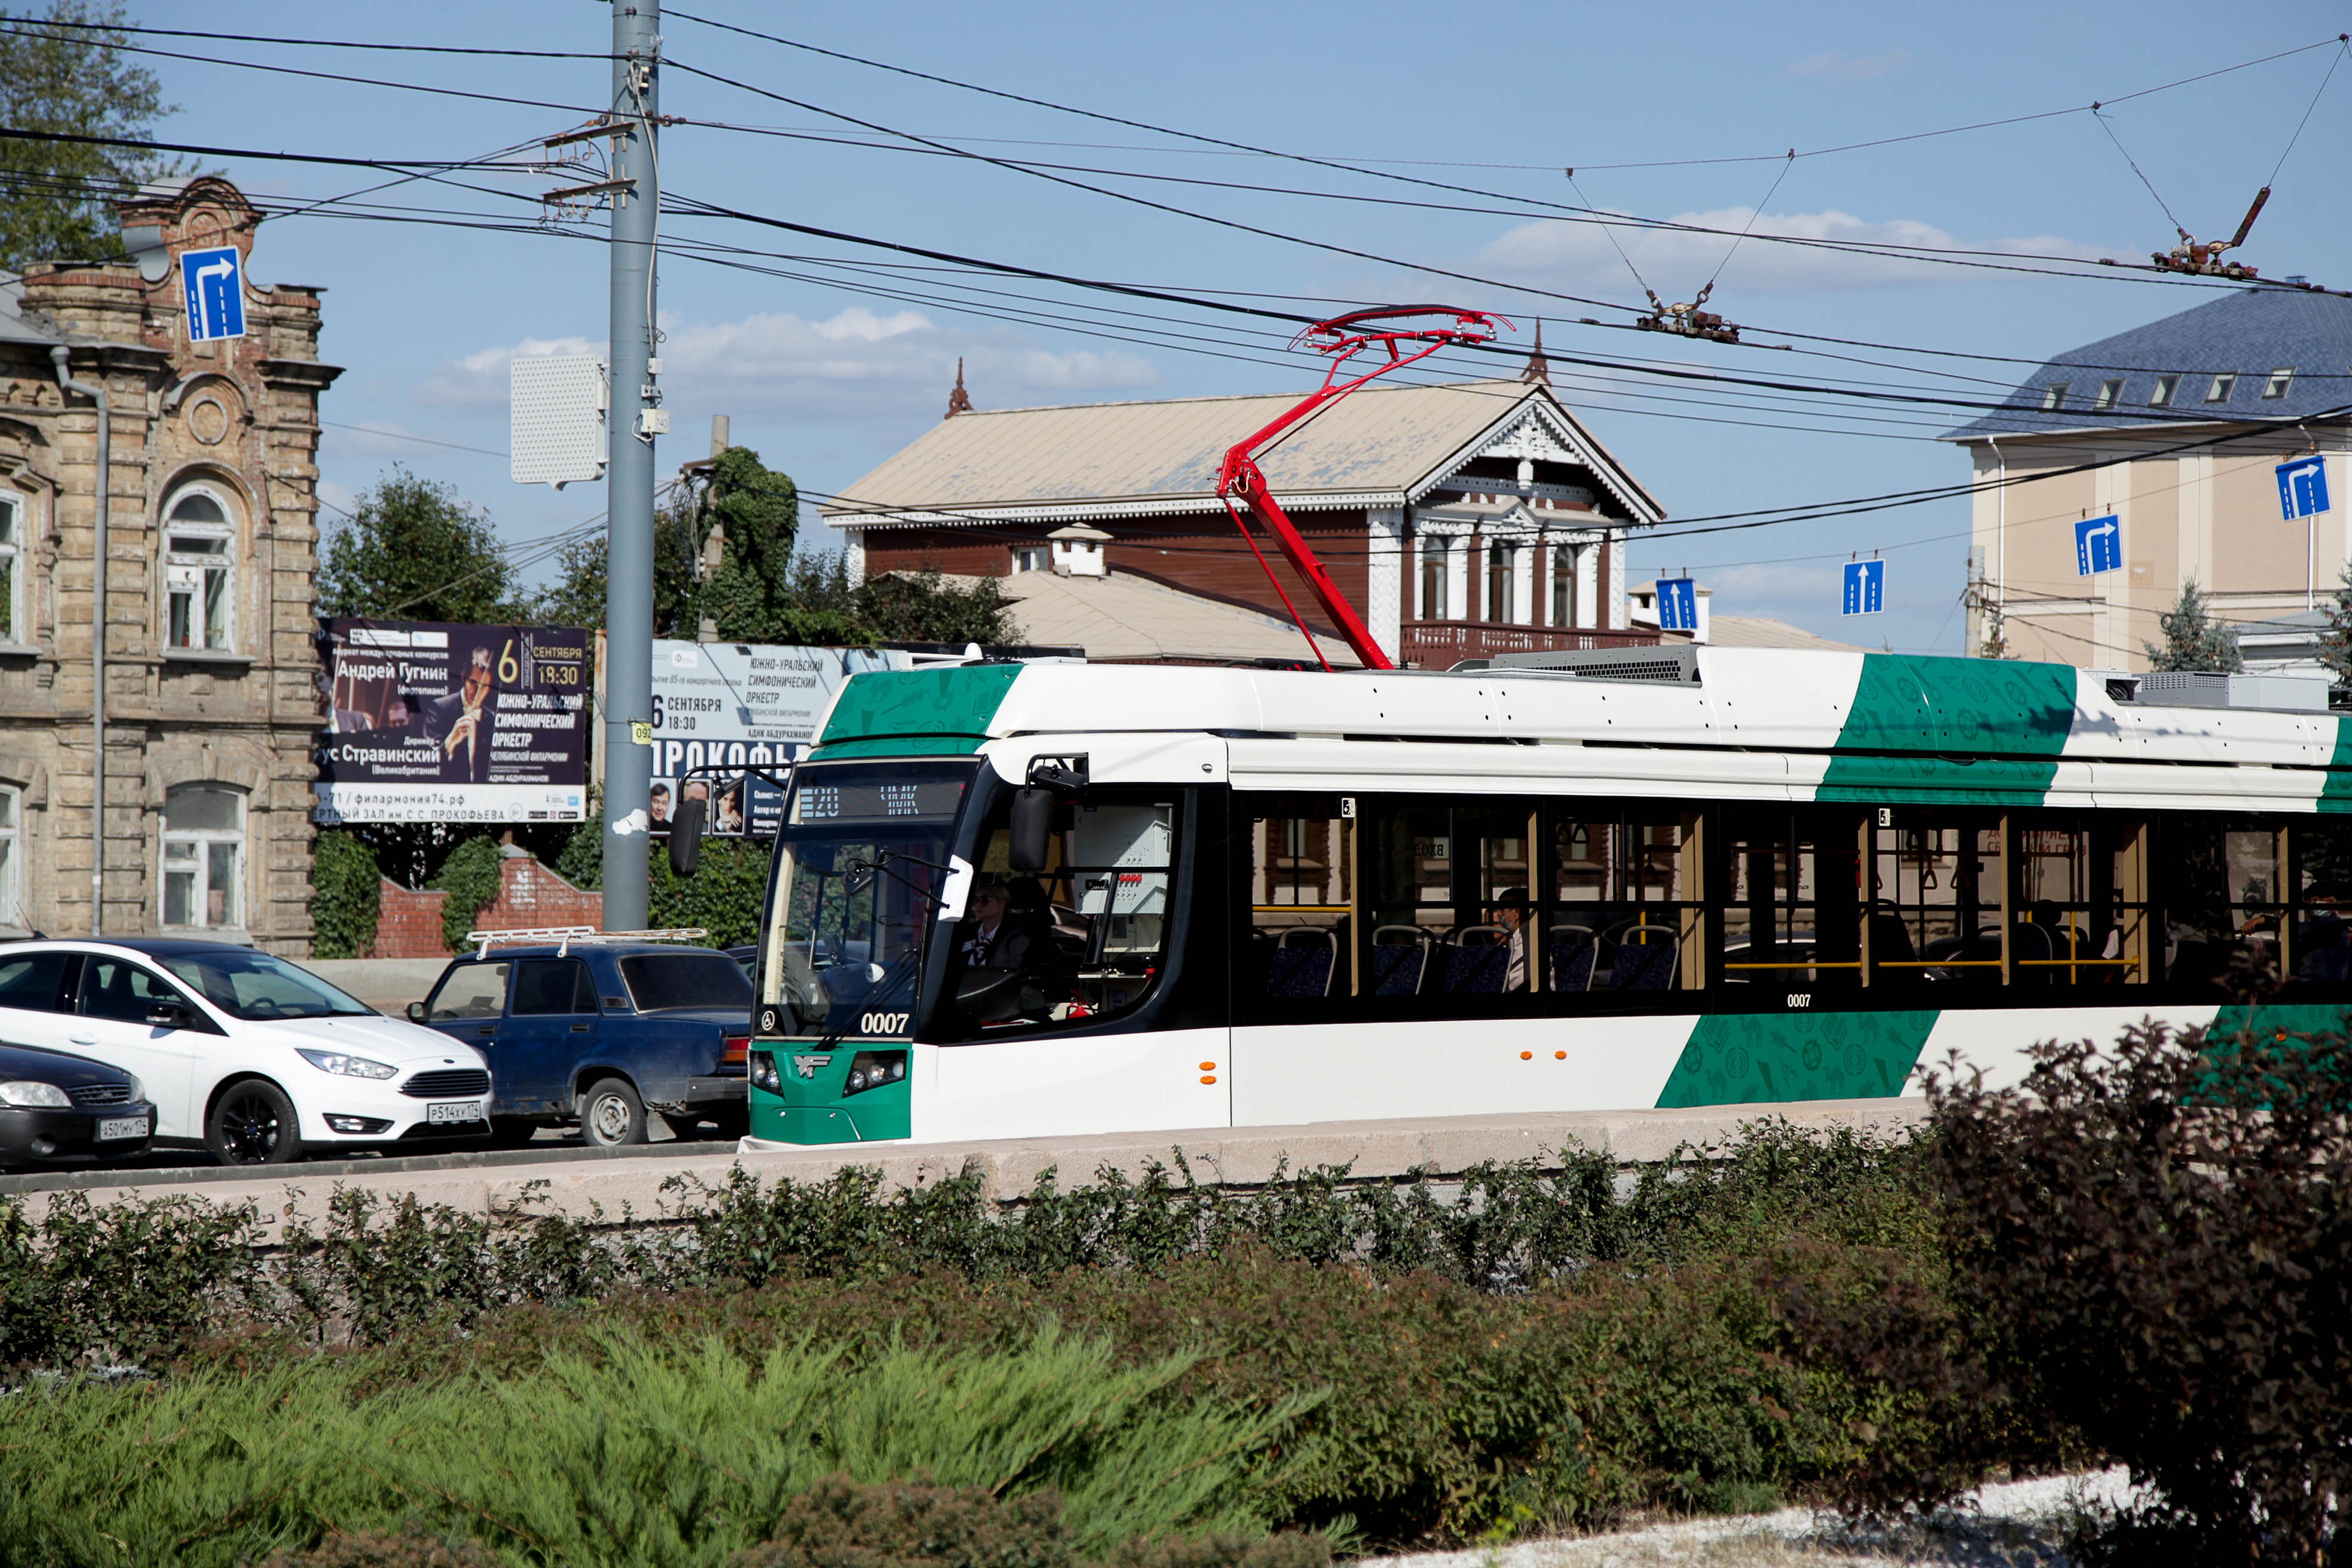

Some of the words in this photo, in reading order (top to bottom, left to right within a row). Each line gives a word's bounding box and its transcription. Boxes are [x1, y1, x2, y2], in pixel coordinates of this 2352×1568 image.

[415, 650, 449, 661] конкурсов
[533, 646, 583, 659] СЕНТЯБРЯ
[498, 639, 519, 683] 6
[750, 658, 823, 672] ЮЖНО-УРАЛЬСКИЙ
[337, 660, 395, 682] Андрей
[399, 662, 449, 683] Гугнин
[538, 665, 578, 685] 18:30
[748, 674, 817, 689] СИМФОНИЧЕСКИЙ
[497, 693, 584, 710] ЮЖНО-УРАЛЬСКИЙ
[667, 696, 722, 712] СЕНТЯБРЯ
[746, 692, 779, 704] ОРКЕСТР
[495, 713, 575, 729] СИМФОНИЧЕСКИЙ
[669, 716, 696, 730] 18:30
[492, 732, 533, 747] ОРКЕСТР
[747, 729, 764, 738] АДИК
[342, 743, 440, 765] Стравинский
[372, 764, 440, 776] (Великобритания)
[363, 809, 384, 820] ЗАЛ
[431, 809, 505, 820] ПРОКОФЬЕВА
[1787, 994, 1811, 1007] 0007
[861, 1012, 909, 1034] 0007
